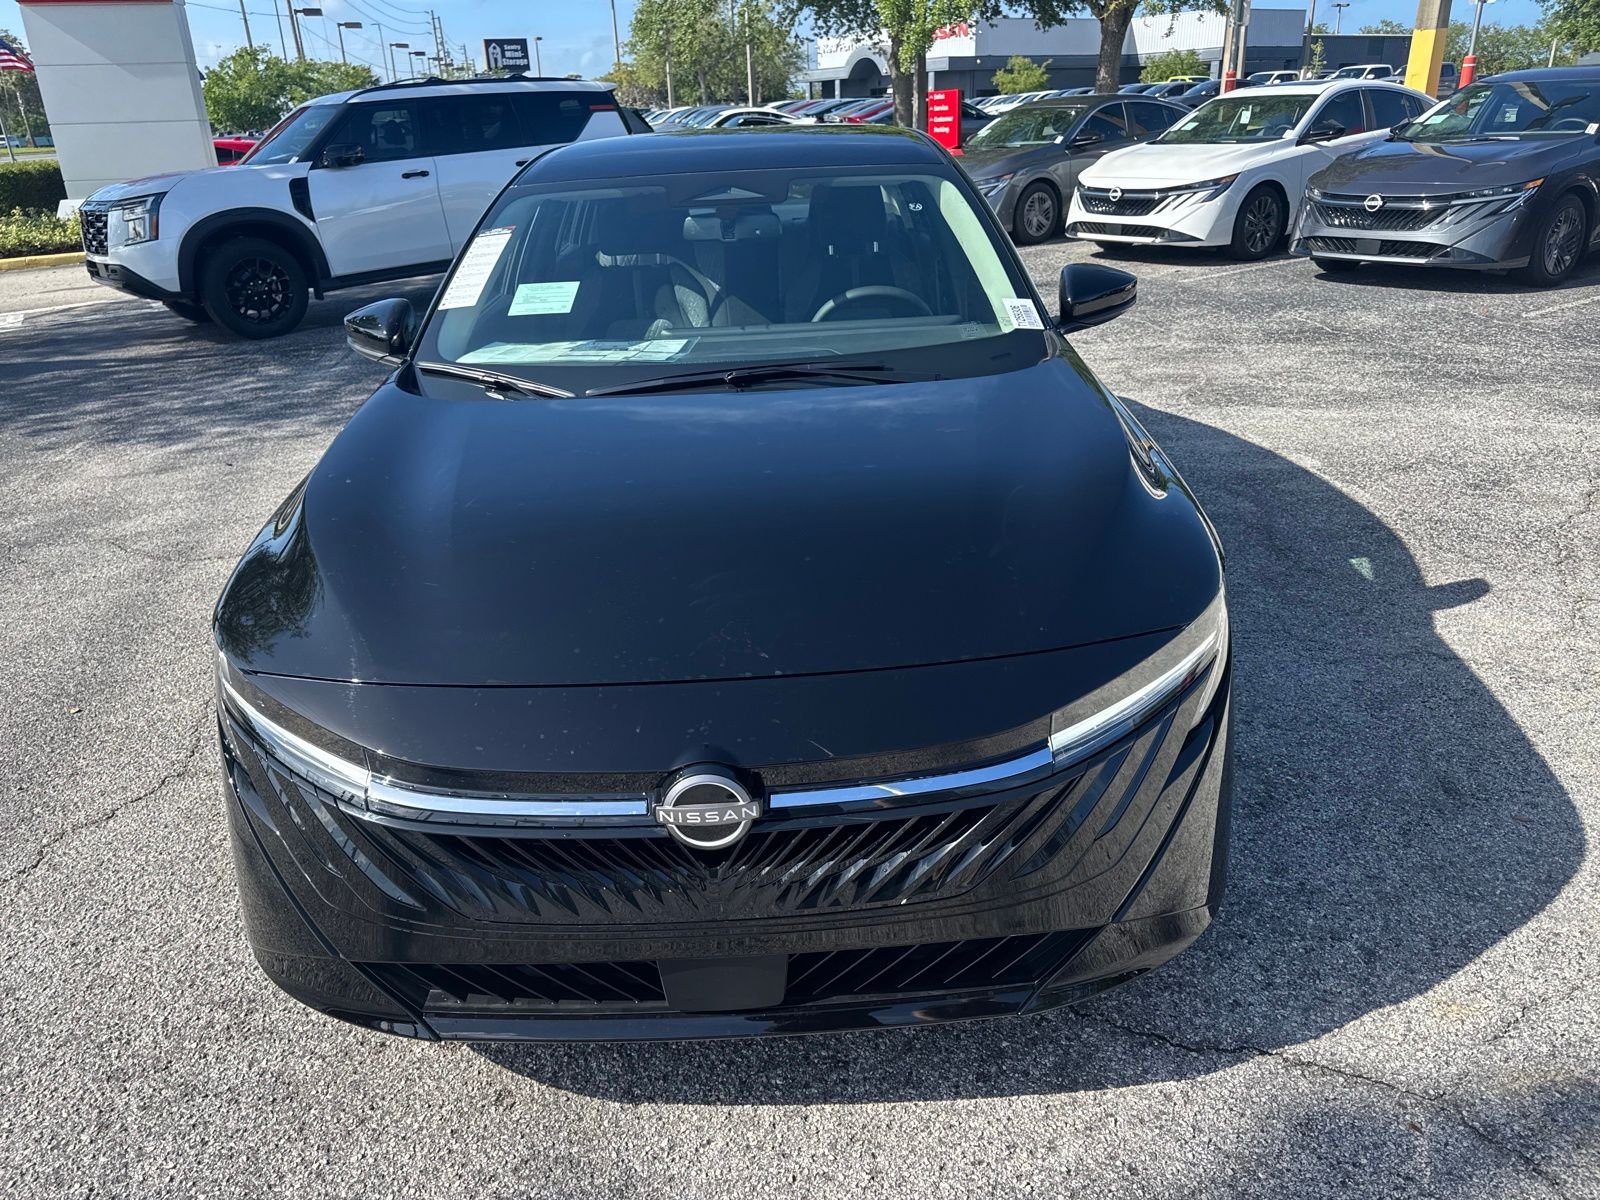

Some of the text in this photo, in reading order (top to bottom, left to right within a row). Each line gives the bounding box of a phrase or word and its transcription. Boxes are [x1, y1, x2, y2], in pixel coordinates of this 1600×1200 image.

[502, 58, 529, 66] Storage
[933, 126, 950, 134] Parking
[659, 805, 757, 823] NISSAN
